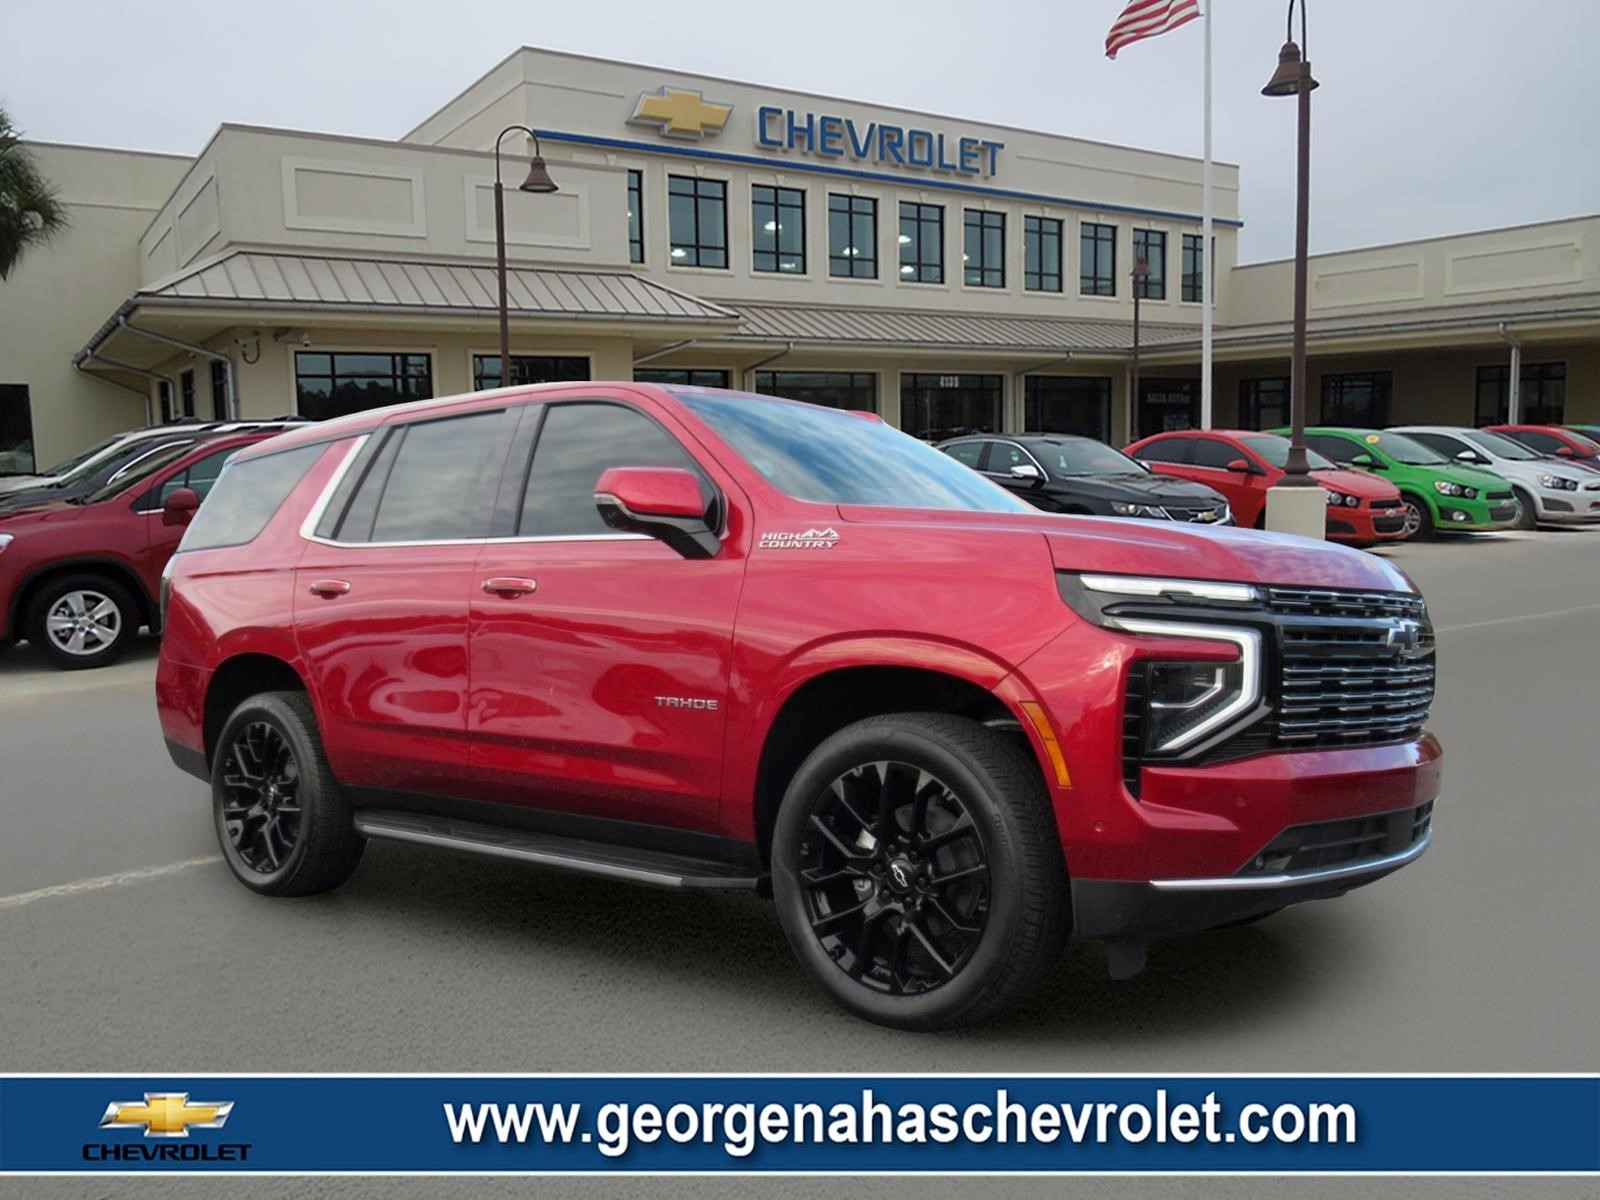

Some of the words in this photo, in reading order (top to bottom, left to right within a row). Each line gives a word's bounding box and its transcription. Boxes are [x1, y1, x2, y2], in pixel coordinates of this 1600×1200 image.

[757, 105, 1005, 177] CHEVROLET
[761, 532, 800, 540] HIGH
[759, 540, 838, 548] COUNTRY
[654, 696, 719, 710] TAHOE
